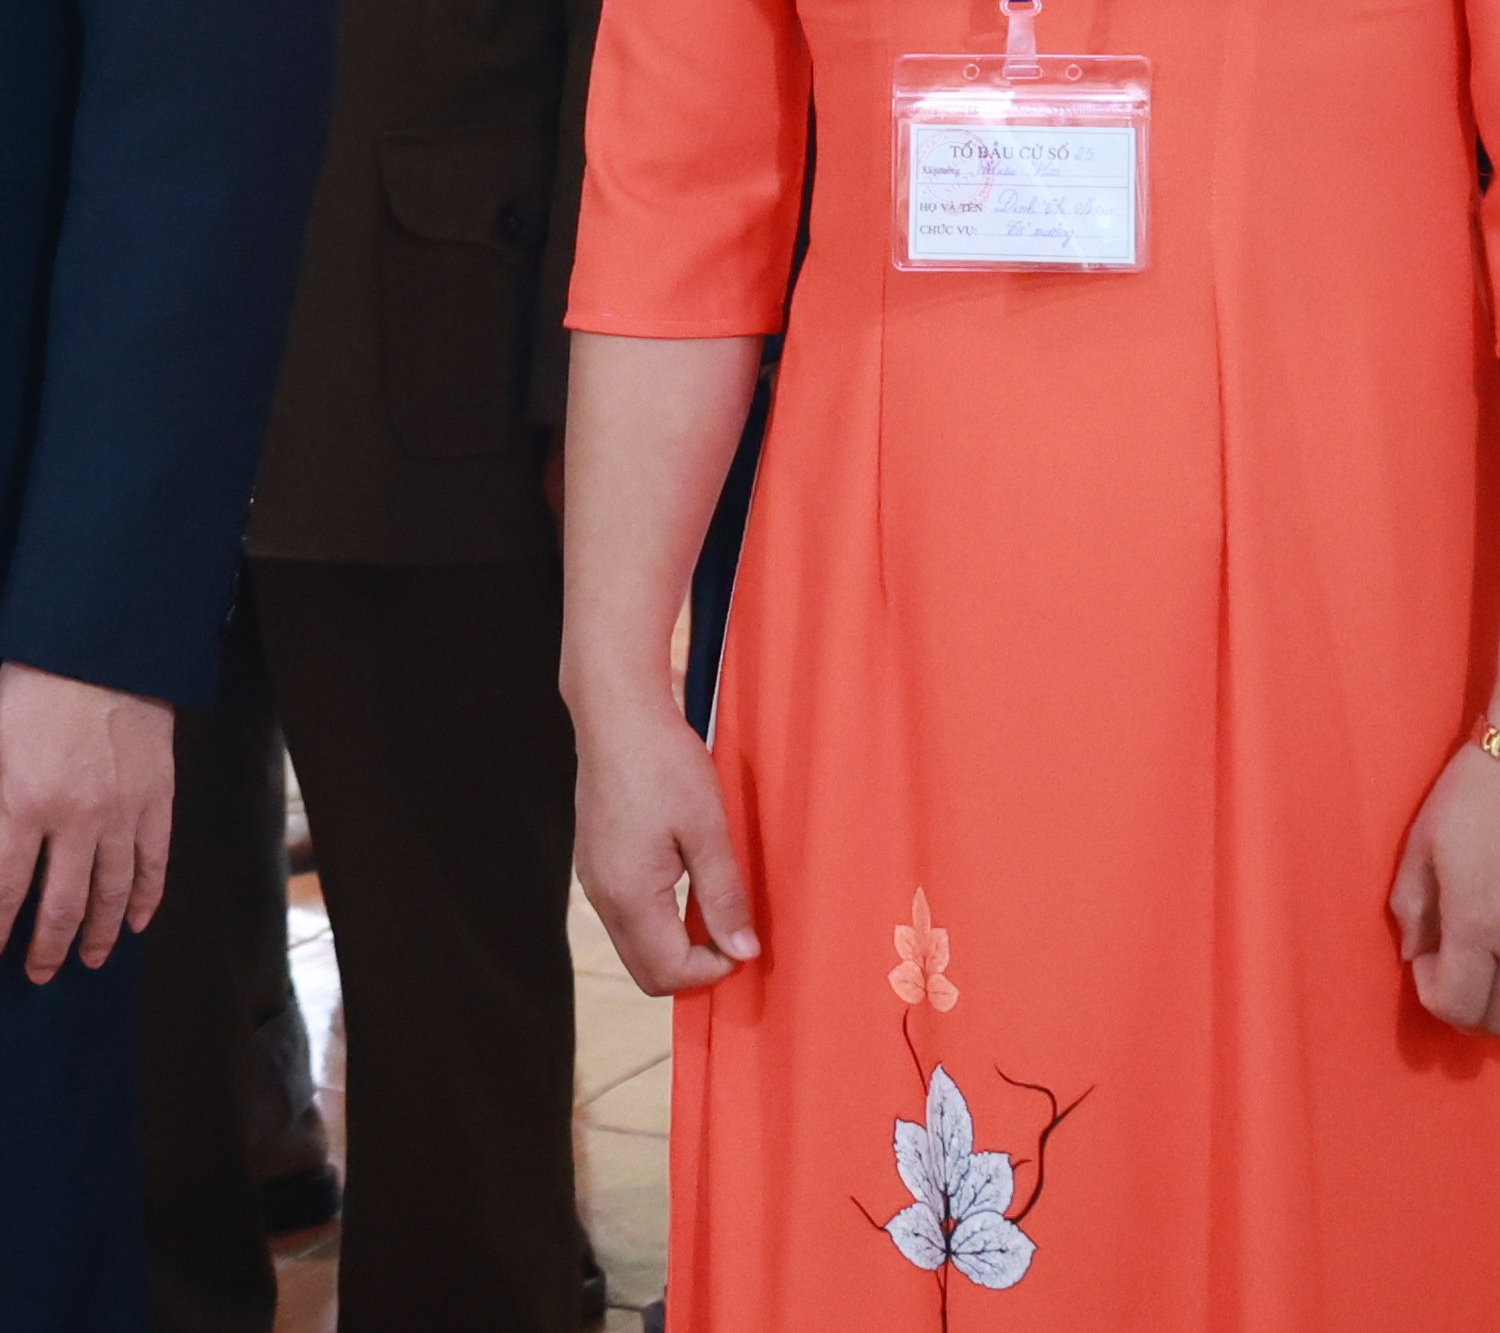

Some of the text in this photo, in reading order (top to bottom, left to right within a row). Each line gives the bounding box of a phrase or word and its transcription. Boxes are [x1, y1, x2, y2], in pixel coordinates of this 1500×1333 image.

[950, 140, 973, 159] TỔ
[1019, 143, 1043, 160] CỬ
[1048, 142, 1070, 160] SỐ
[920, 203, 937, 213] HỌ
[920, 223, 954, 235] CHỨC
